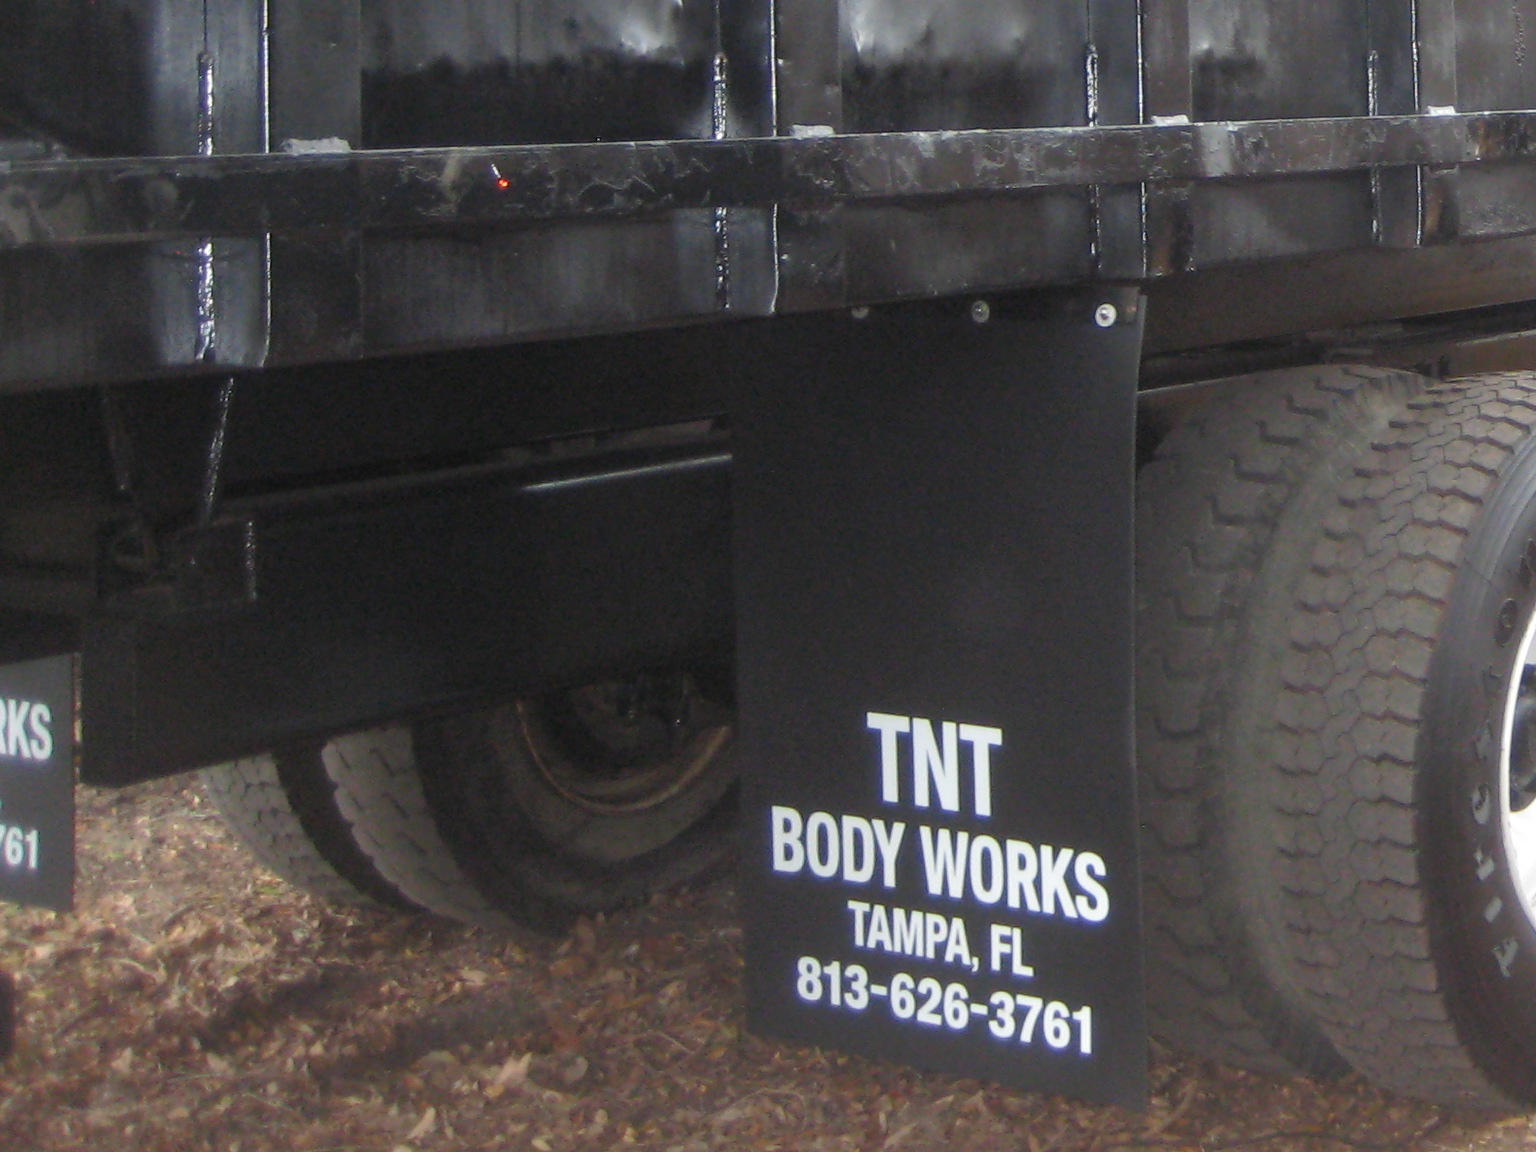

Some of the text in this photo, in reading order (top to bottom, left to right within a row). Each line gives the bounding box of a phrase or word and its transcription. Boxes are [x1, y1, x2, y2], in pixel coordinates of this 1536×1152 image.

[866, 711, 1003, 817] TNT
[771, 804, 1110, 923] BODY WORKS
[847, 900, 1035, 978] TAMPA, FL
[796, 955, 1093, 1055] 813-626-3761
